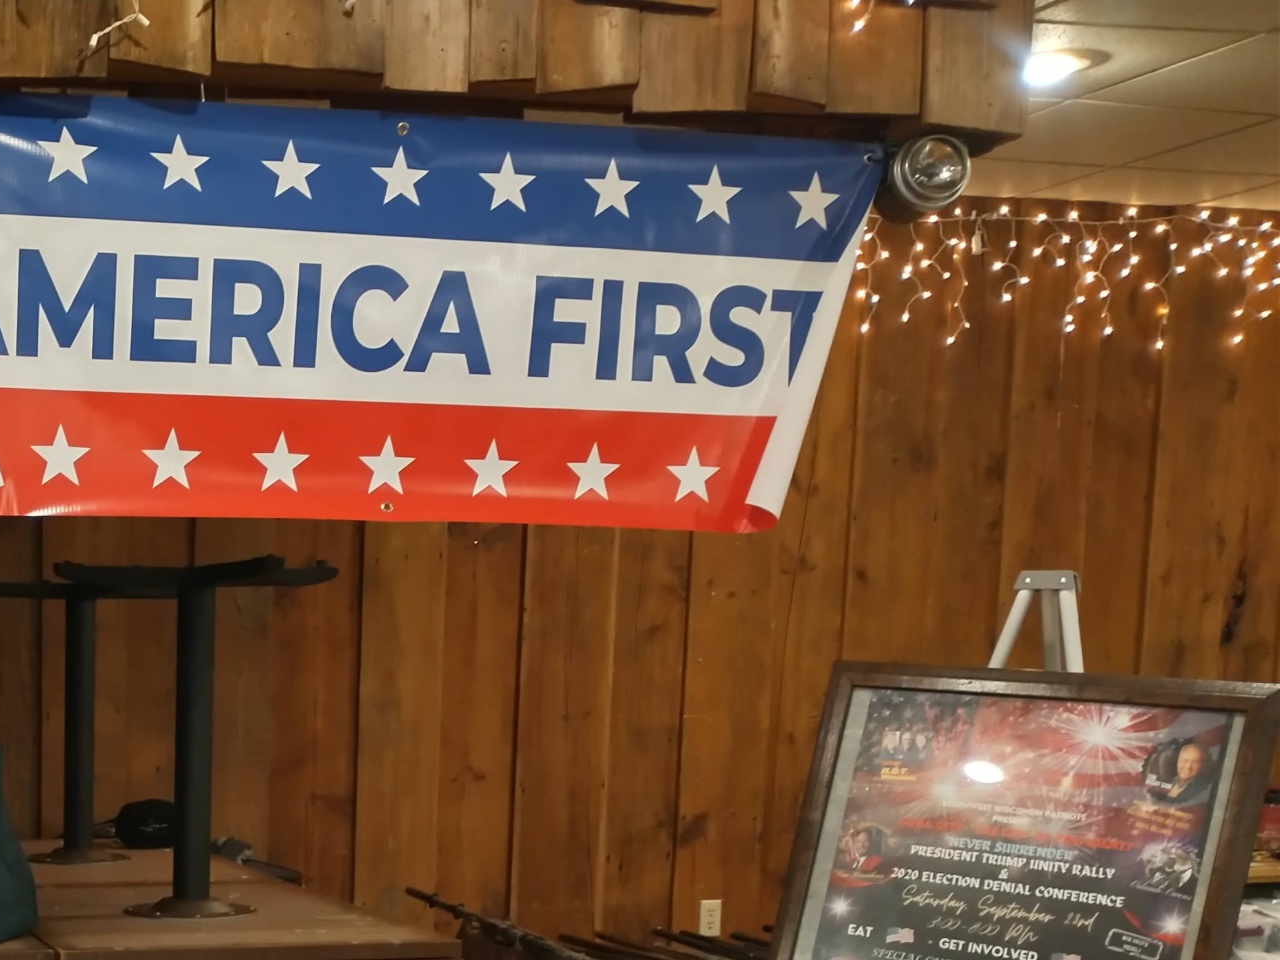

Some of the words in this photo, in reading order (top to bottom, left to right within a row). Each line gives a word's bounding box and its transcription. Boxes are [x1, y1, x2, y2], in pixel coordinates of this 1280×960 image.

[526, 273, 824, 388] FIRST
[911, 845, 979, 862] PRESIDENT
[981, 853, 1027, 867] TRUMP
[1029, 858, 1070, 874] UNITY
[1072, 864, 1116, 879] RALLY
[999, 868, 1009, 879] &
[891, 867, 919, 880] 2020
[922, 871, 980, 889] ELECTION
[984, 880, 1031, 896] DENIAL
[1035, 885, 1126, 908] CONFERENCE
[848, 924, 874, 938] EAT
[939, 938, 966, 952] GET
